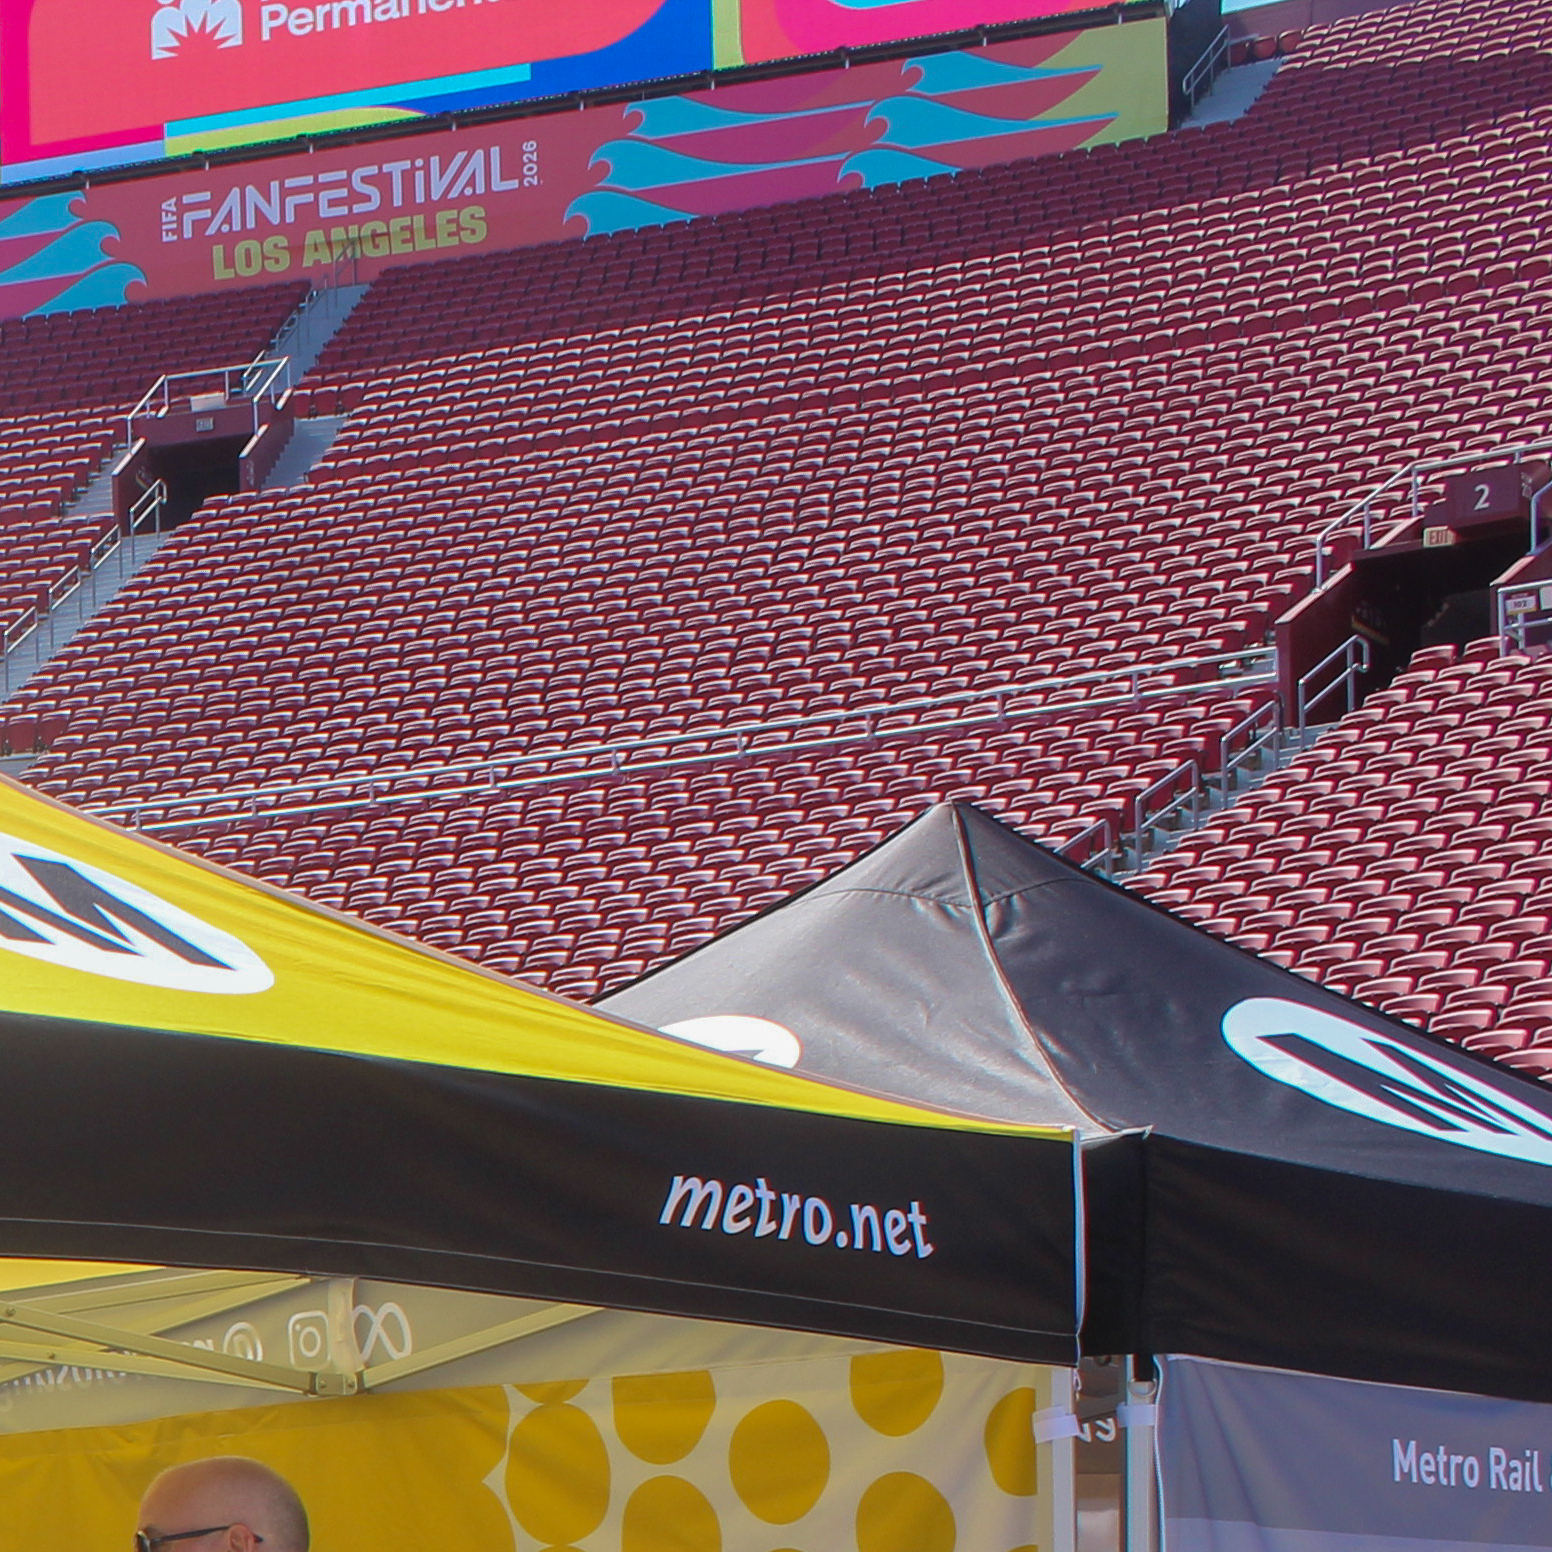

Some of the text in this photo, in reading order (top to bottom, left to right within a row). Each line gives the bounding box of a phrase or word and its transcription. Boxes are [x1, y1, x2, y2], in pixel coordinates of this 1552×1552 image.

[261, 0, 515, 42] Perman
[522, 140, 539, 187] 2026
[161, 196, 178, 242] FIFA
[212, 205, 488, 280] LOS ANGELES
[1474, 484, 1490, 510] 2
[659, 1175, 934, 1259] metro.net
[1393, 1438, 1543, 1493] Metro Rail
